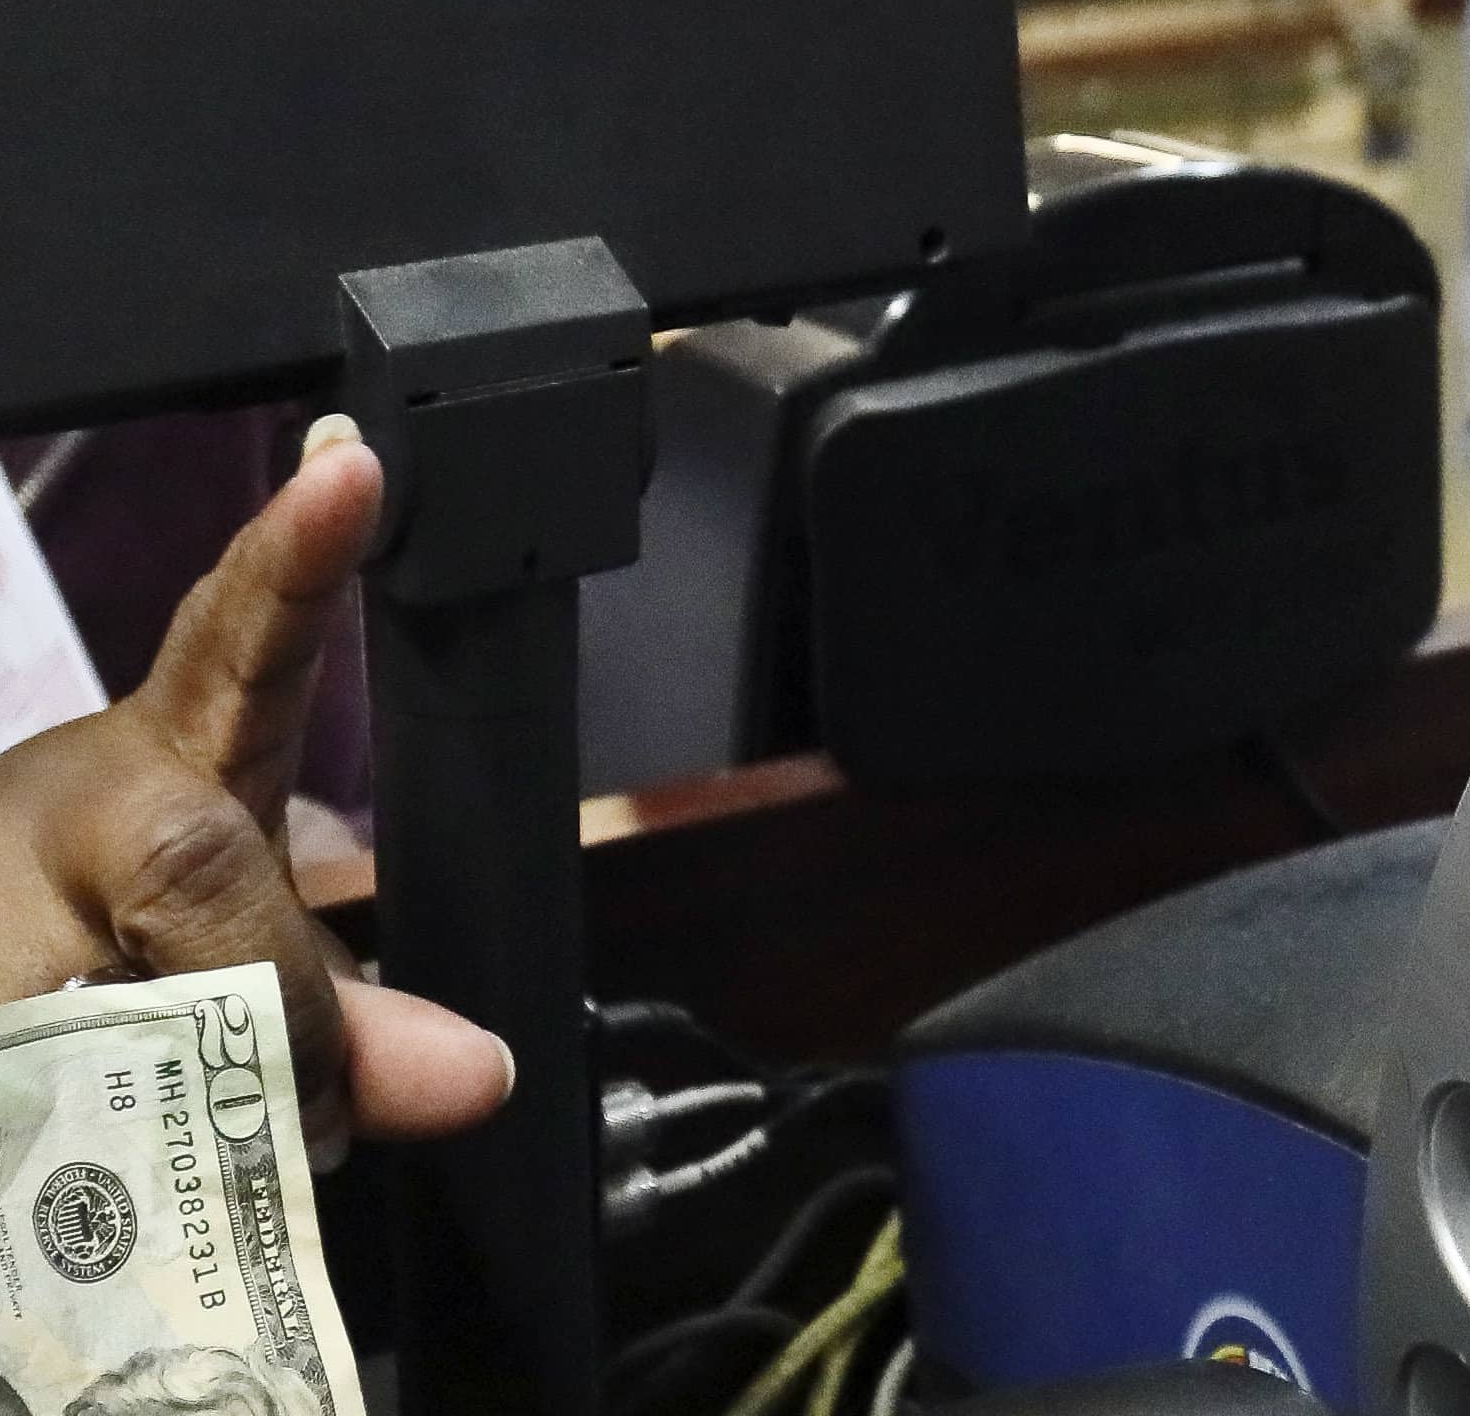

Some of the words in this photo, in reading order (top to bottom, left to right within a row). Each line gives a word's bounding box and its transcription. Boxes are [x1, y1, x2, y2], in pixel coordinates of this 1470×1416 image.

[193, 993, 270, 1144] 20
[105, 1070, 136, 1113] H8
[97, 1172, 131, 1214] UNITED
[111, 1217, 132, 1261] STATES
[249, 1178, 305, 1342] FEDERAL
